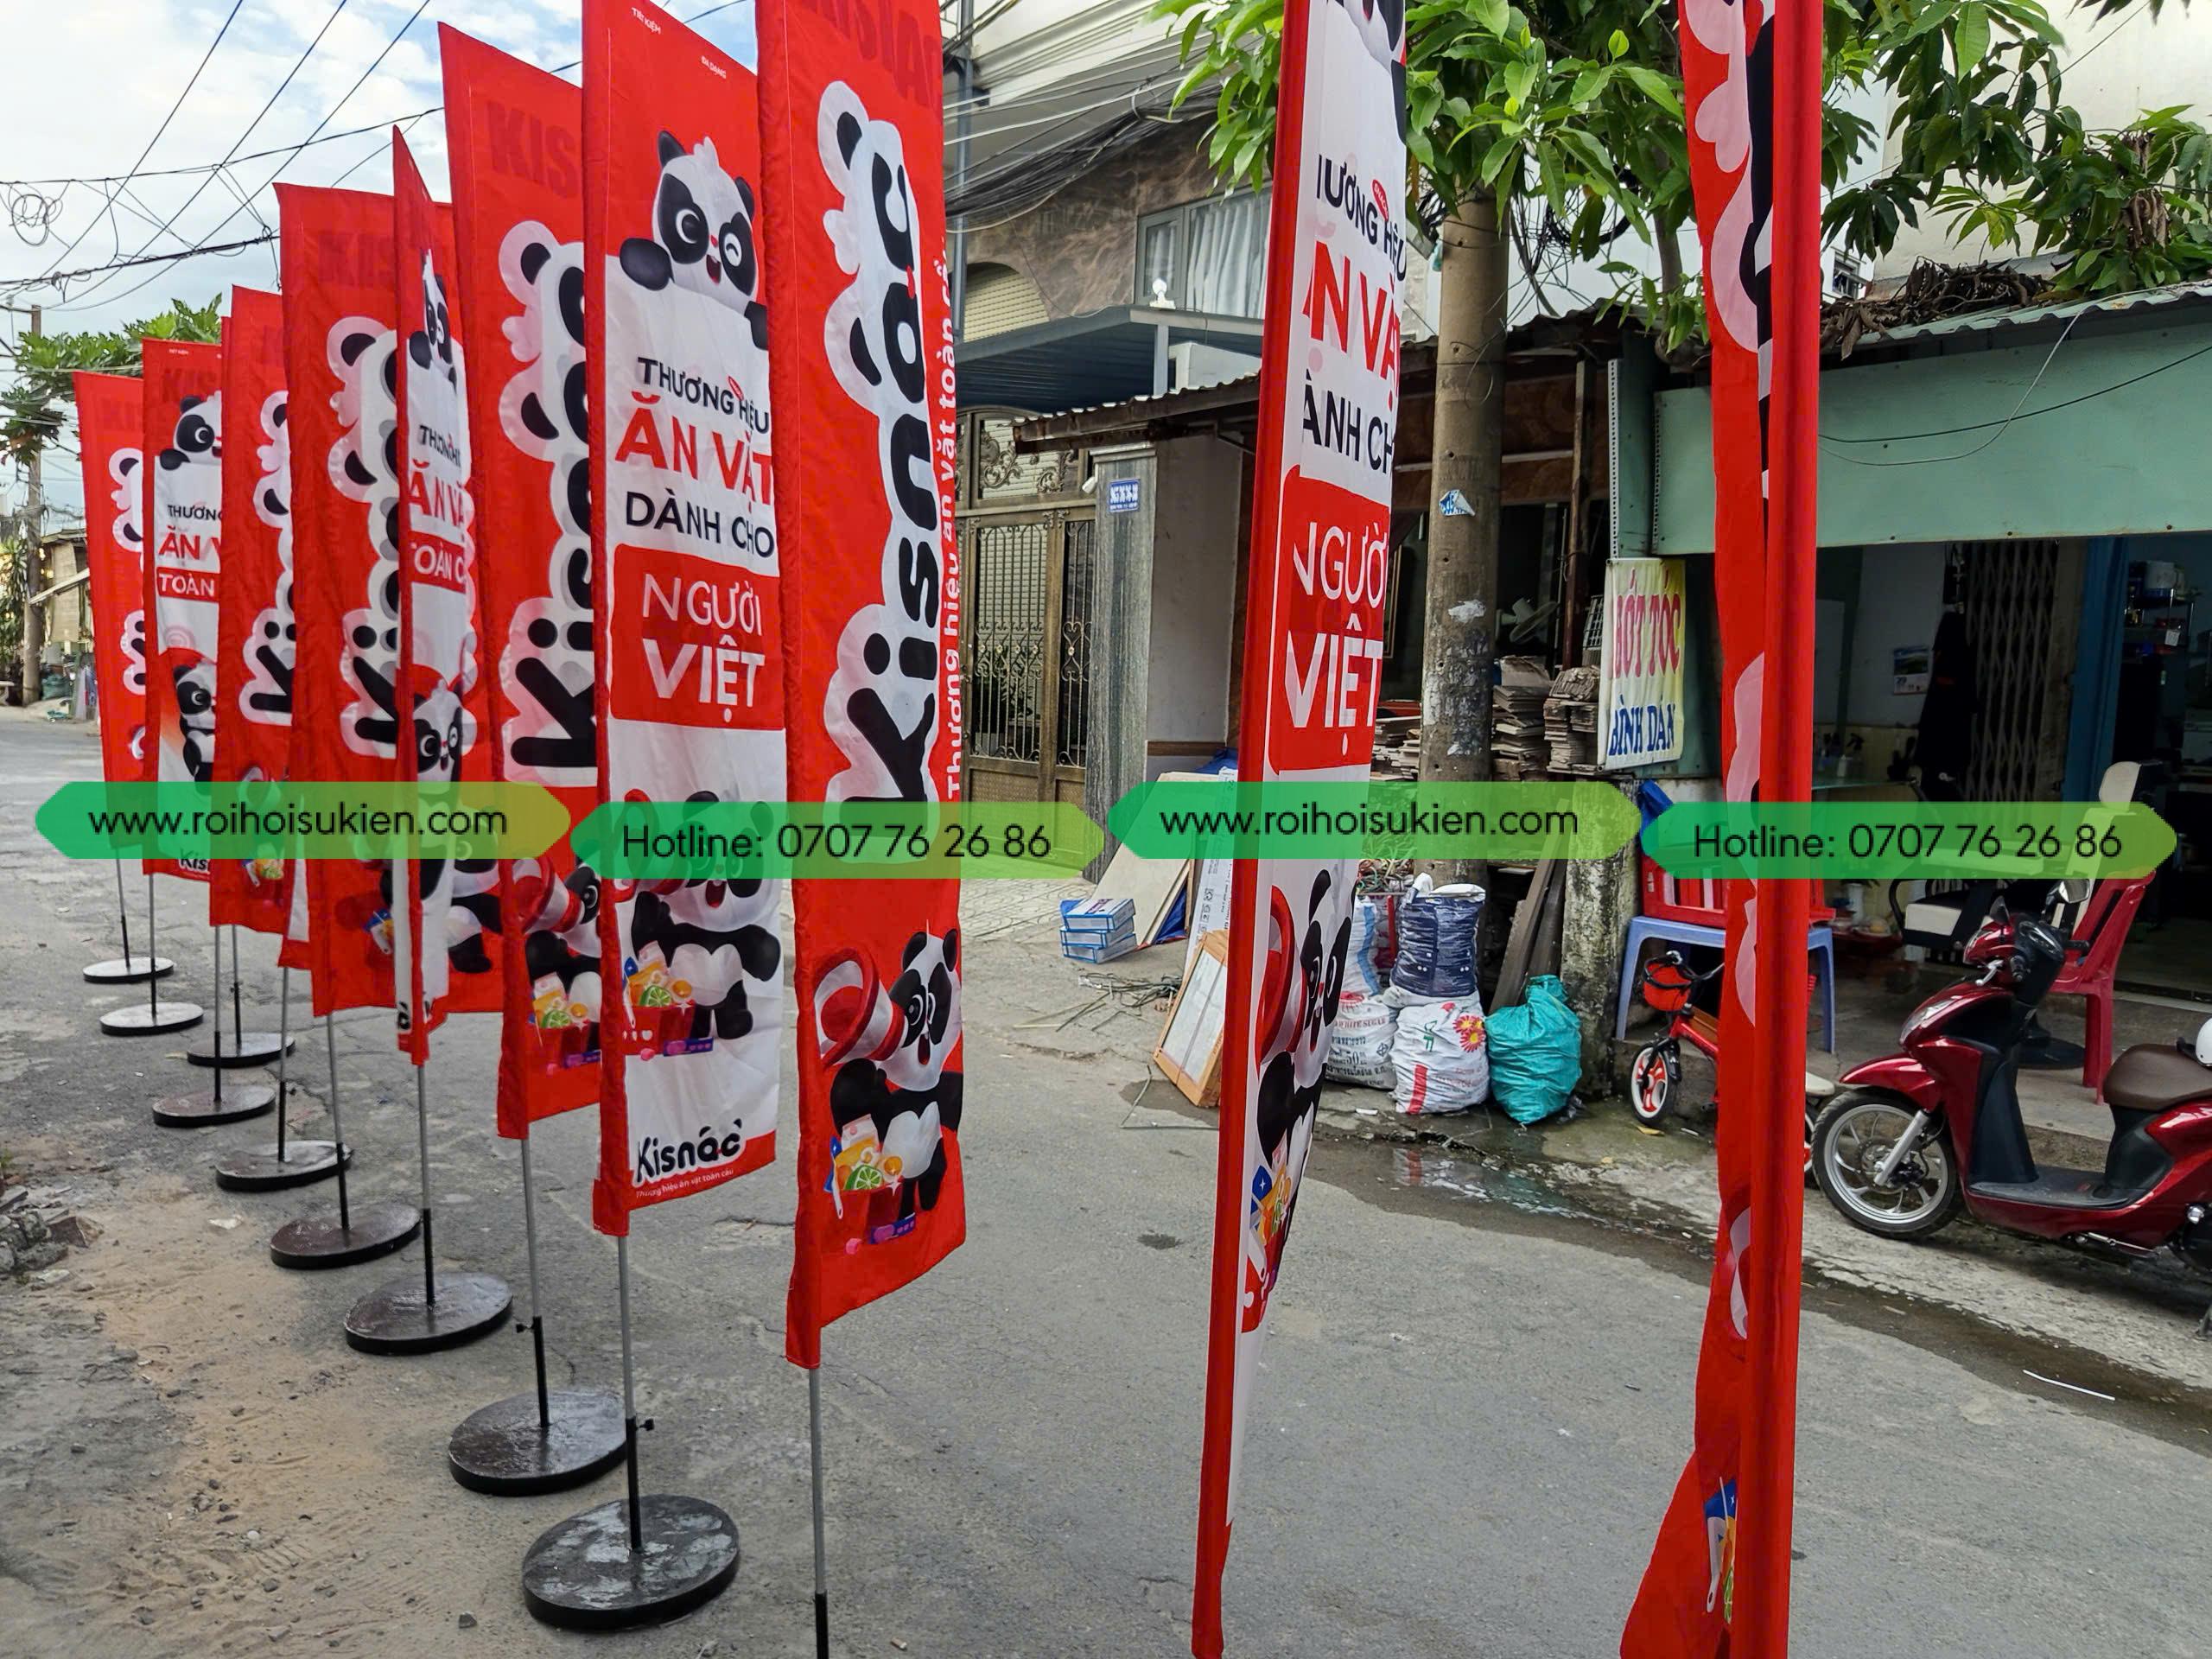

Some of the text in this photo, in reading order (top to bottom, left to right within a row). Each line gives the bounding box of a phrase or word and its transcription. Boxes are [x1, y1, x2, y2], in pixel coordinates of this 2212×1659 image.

[638, 356, 734, 415] THƯƠNG
[614, 391, 772, 513] ĂN VẬT
[158, 524, 200, 560] ĂN
[626, 487, 775, 557] DÀNH CHO
[158, 572, 215, 597] TOÀN
[642, 573, 762, 636] NGƯỜI
[642, 634, 766, 723] VIỆT
[1285, 613, 1384, 757] VIỆT
